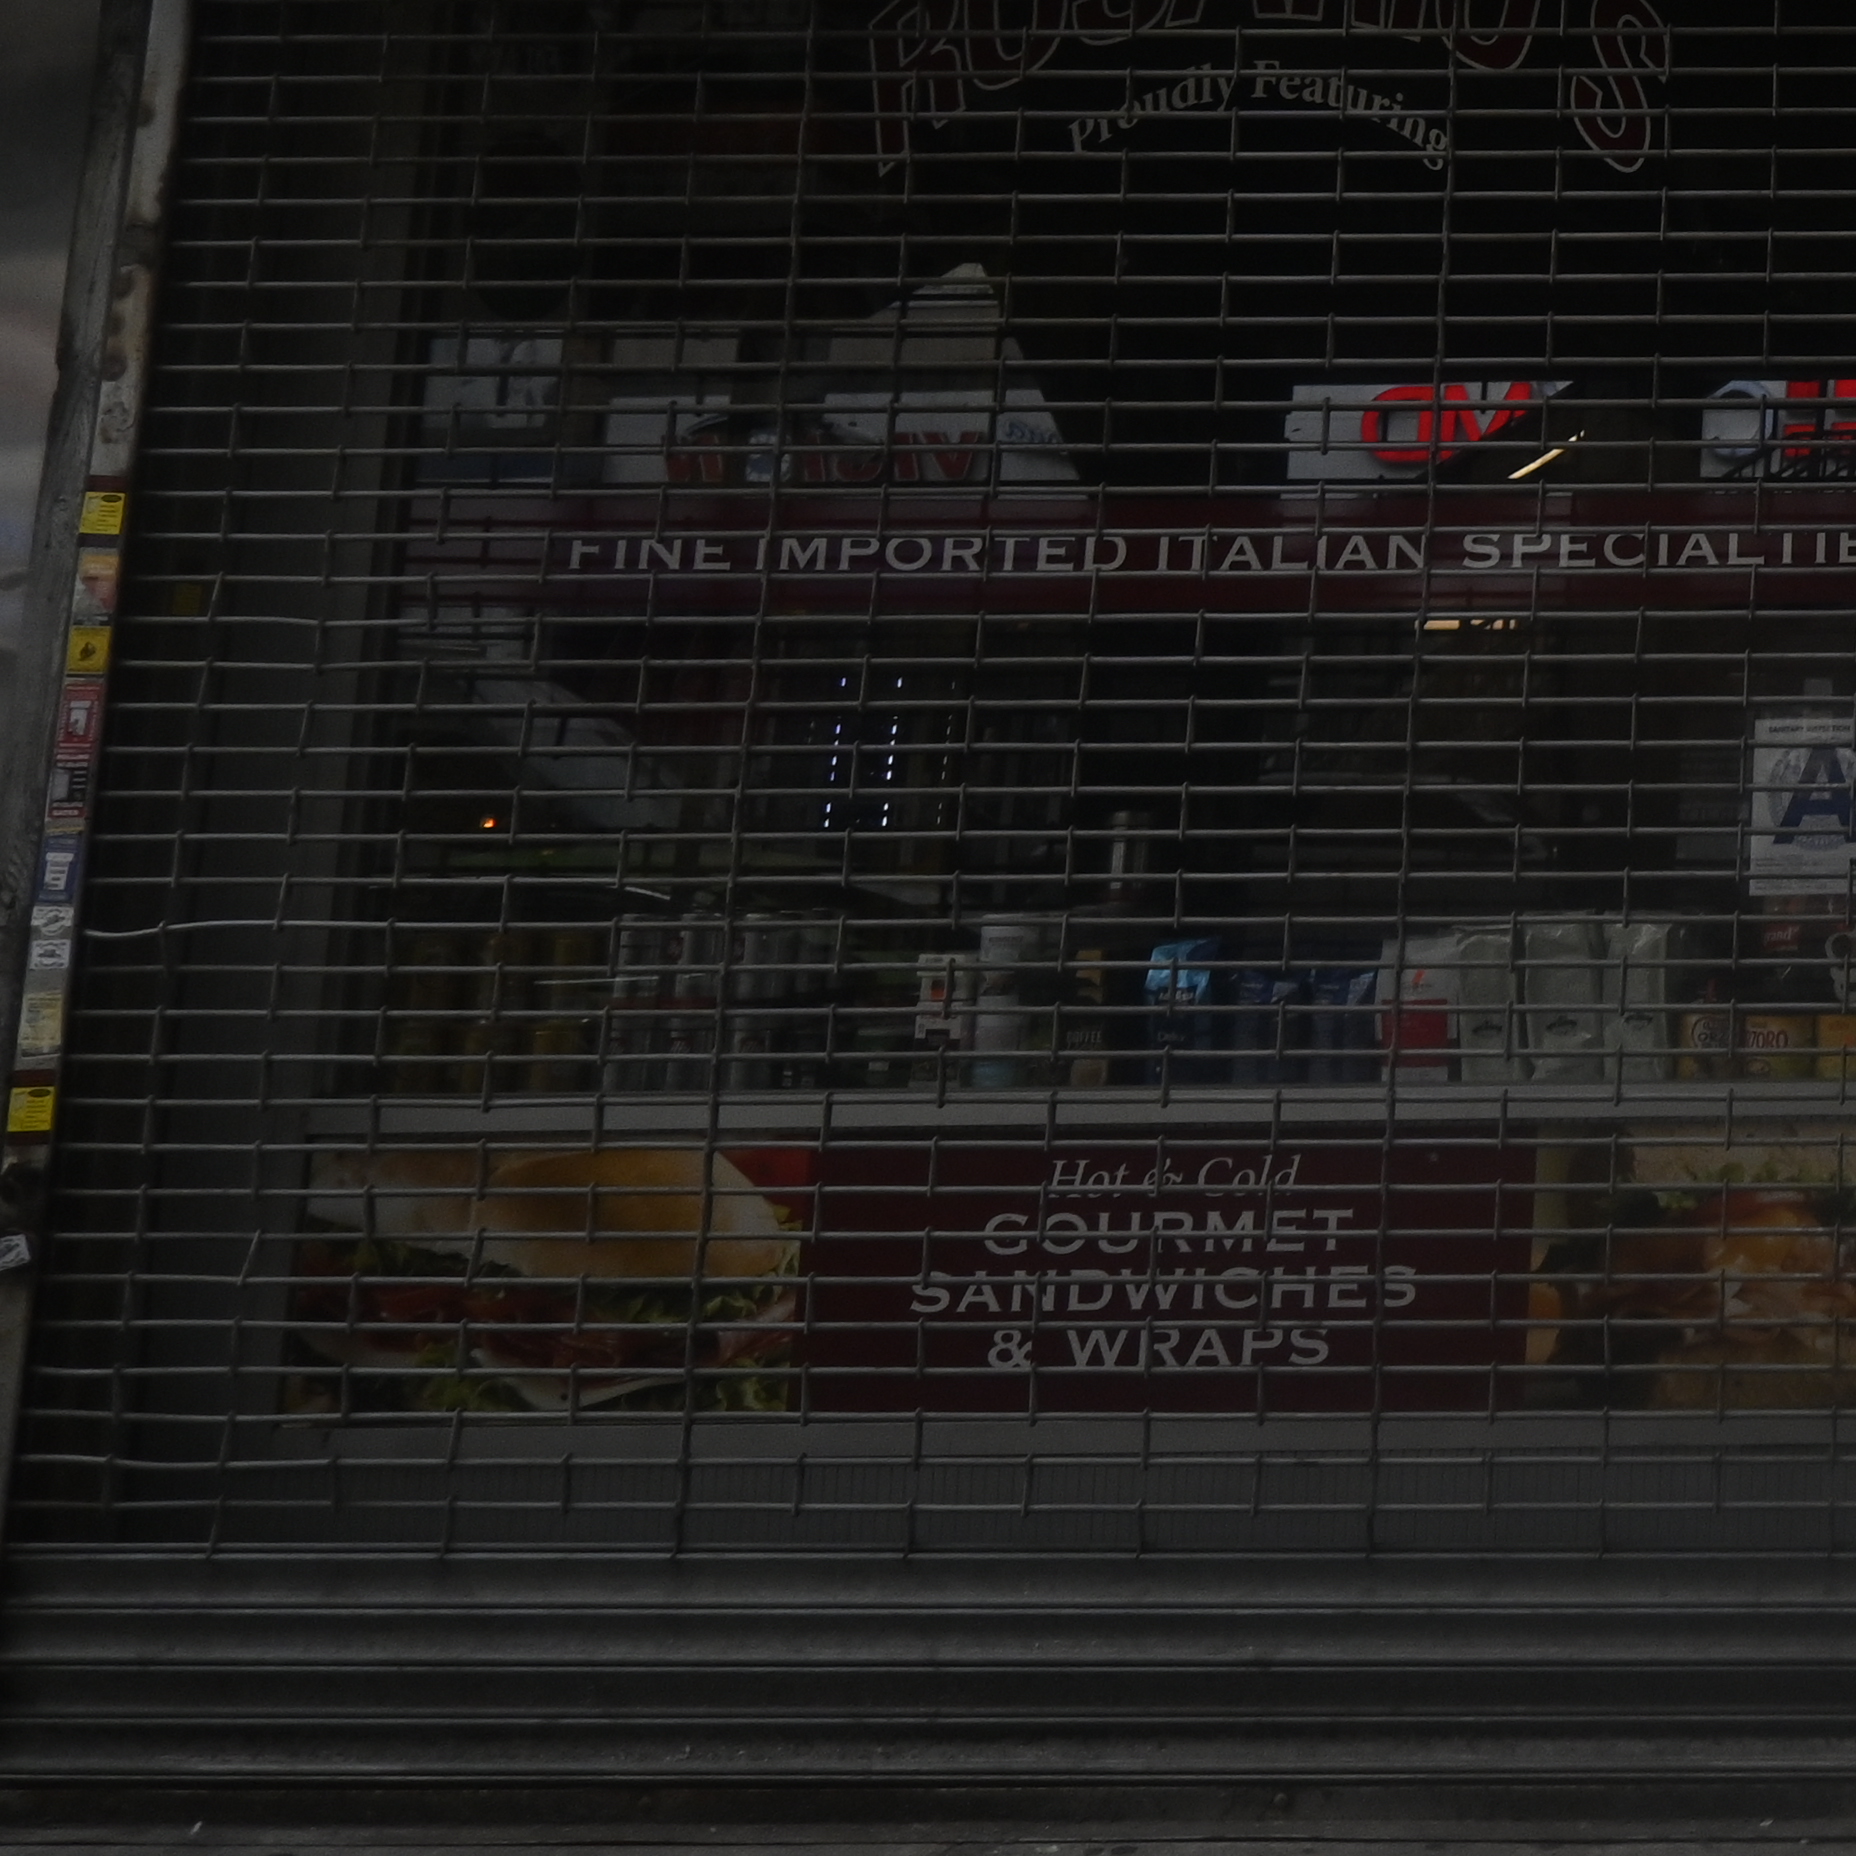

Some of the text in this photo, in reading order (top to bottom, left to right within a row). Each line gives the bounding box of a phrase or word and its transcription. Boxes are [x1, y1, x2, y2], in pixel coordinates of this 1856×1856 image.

[1067, 58, 1451, 173] Proudly Featuring
[568, 533, 735, 572] FINE
[755, 533, 1129, 572] IMPORTED
[1158, 529, 1426, 572] ITALIAN
[1049, 1156, 1129, 1201] Hot
[1202, 1152, 1303, 1198] Cold
[982, 1207, 1356, 1257] GOURMET
[908, 1264, 1417, 1315] SANDWICHES
[986, 1326, 1330, 1370] & WRAPS
